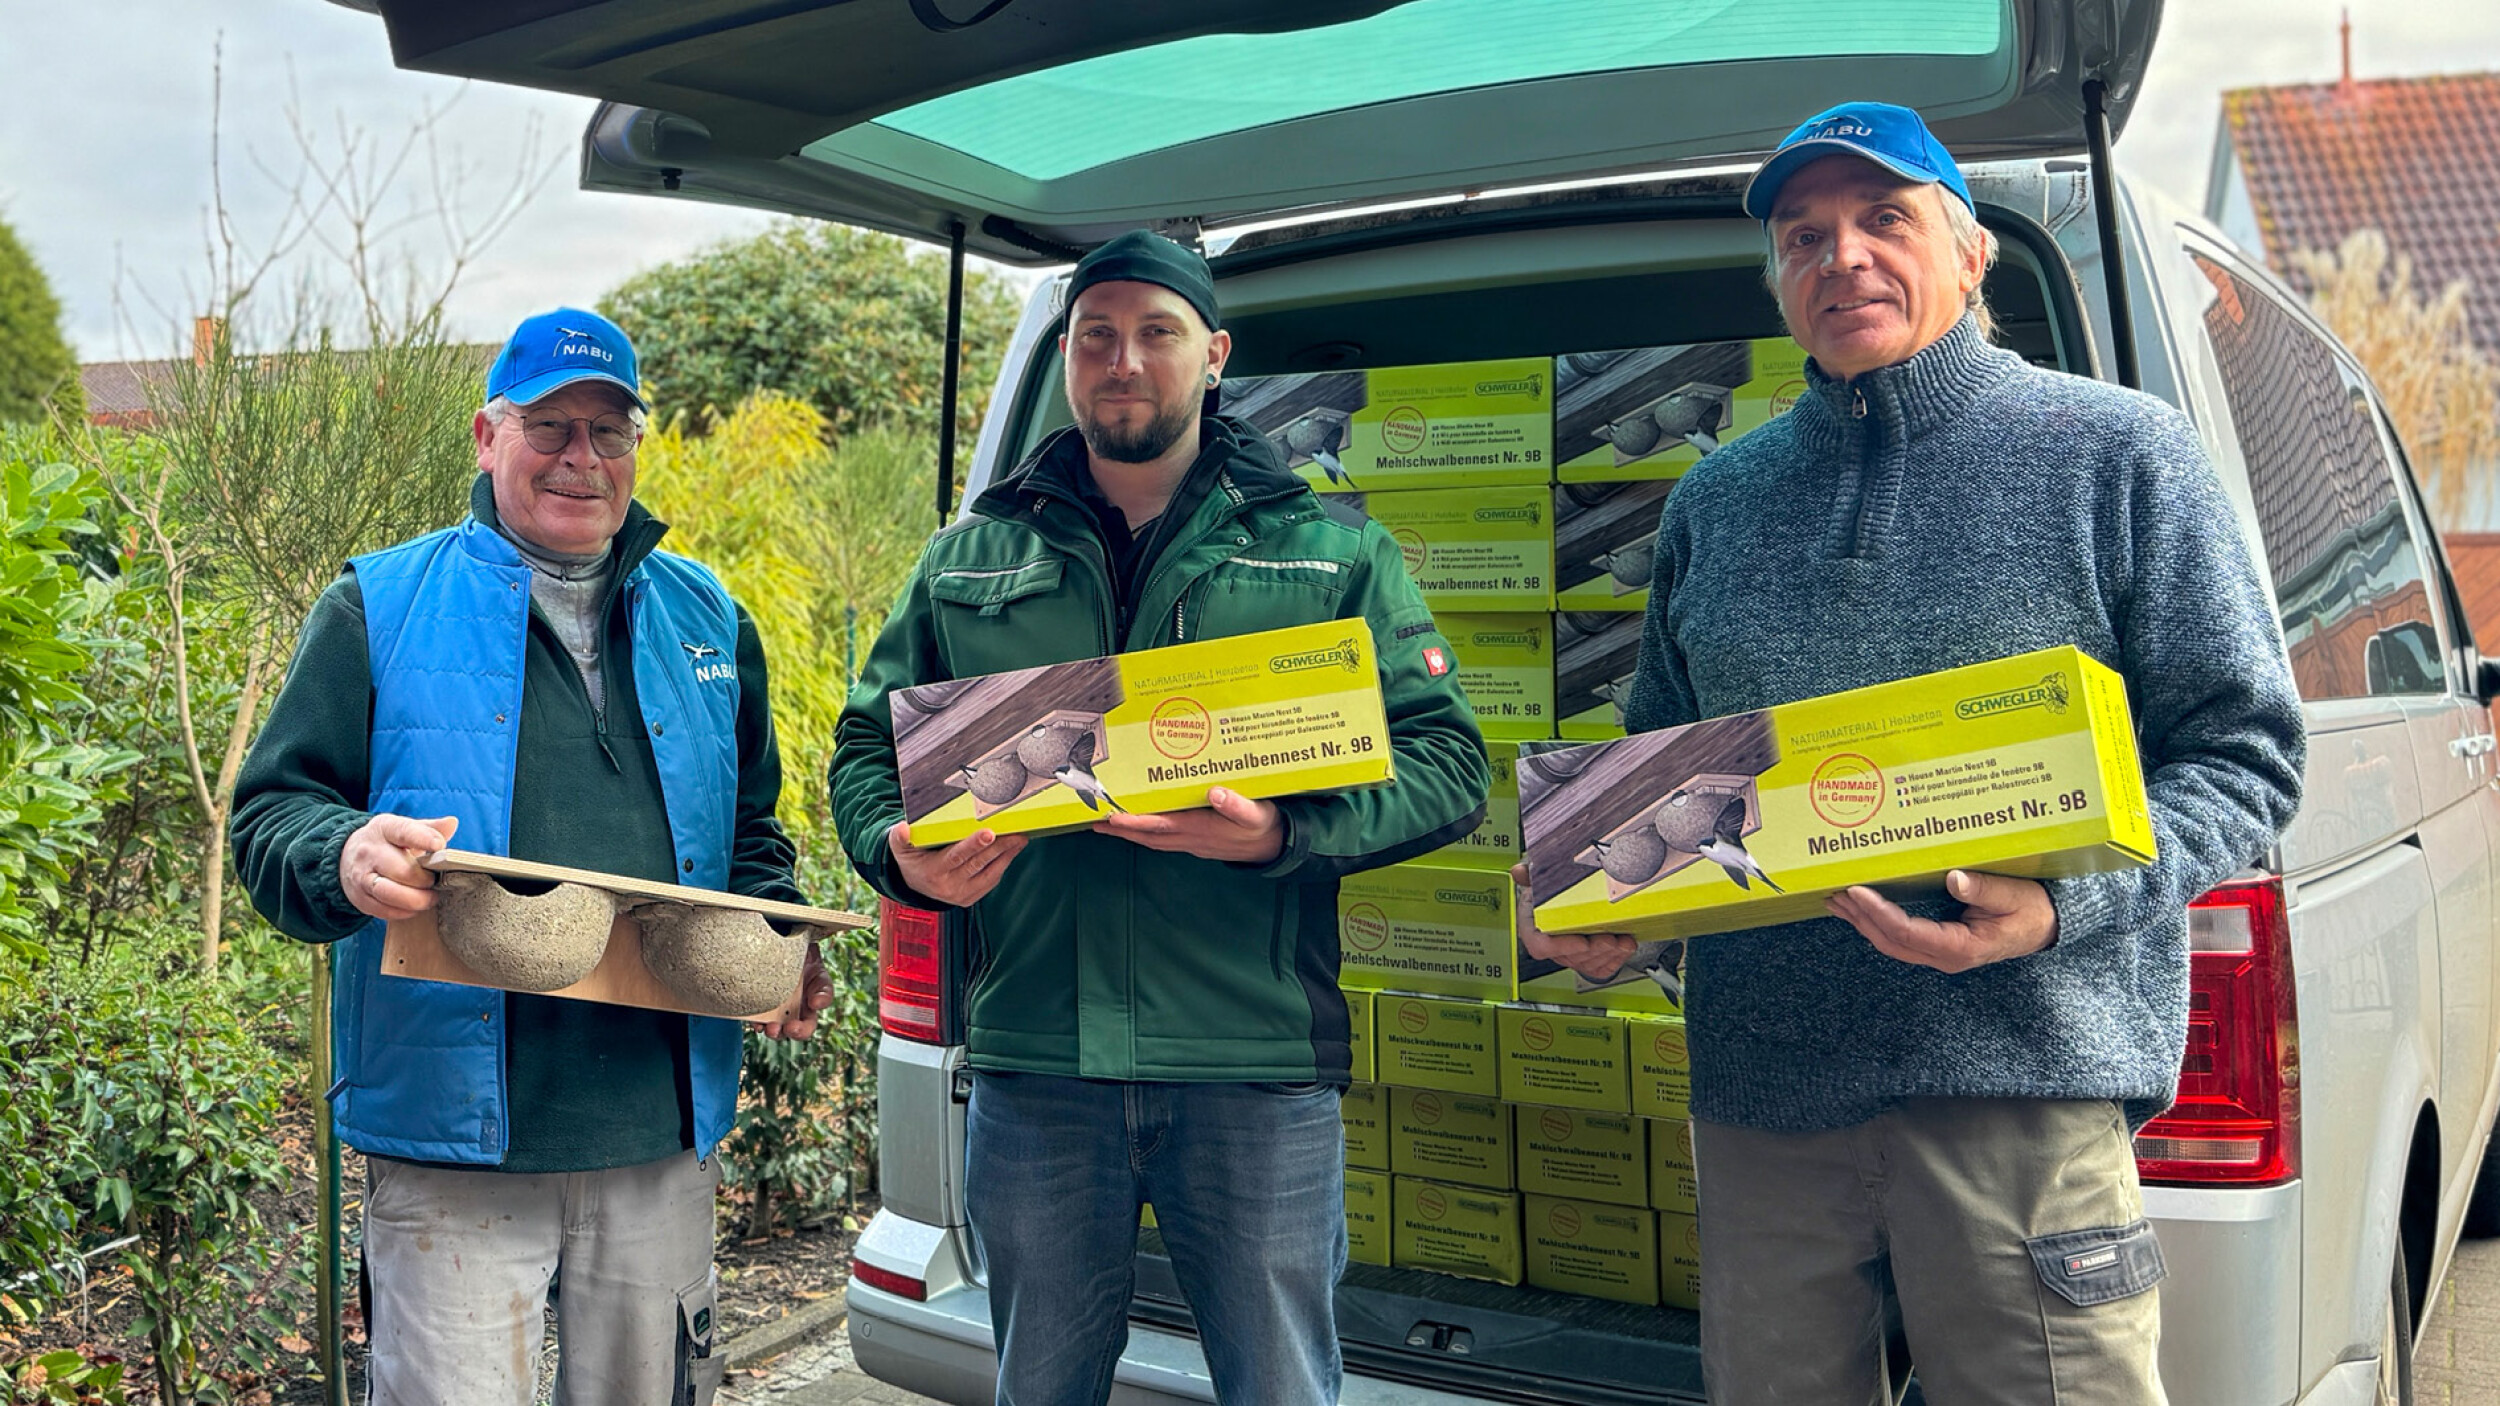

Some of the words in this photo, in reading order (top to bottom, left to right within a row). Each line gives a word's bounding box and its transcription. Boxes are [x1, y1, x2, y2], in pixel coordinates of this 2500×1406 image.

[562, 344, 613, 363] NABU
[1478, 382, 1529, 393] SCHWEGLER
[1376, 452, 1499, 469] Mehlschwalbennest
[1503, 450, 1521, 464] Nr.
[1525, 449, 1541, 463] 9B
[1476, 510, 1528, 520] SCHWEGLER
[1416, 578, 1499, 591] hwalbennest
[1502, 576, 1521, 590] Nr.
[1524, 576, 1541, 590] 9B
[1273, 650, 1342, 670] SCHWEGLER
[695, 663, 736, 683] NABU
[1134, 671, 1207, 690] NATURMATERIAL
[1502, 703, 1521, 716] Nr.
[1524, 703, 1542, 716] 9B
[1960, 689, 2048, 716] SCHWEGLER
[1154, 718, 1205, 730] HANDMADE
[1790, 720, 1878, 746] NATURMATERIAL
[1889, 709, 1943, 727] Holzbeton
[1156, 728, 1165, 737] in
[1166, 728, 1204, 741] Germany
[1147, 746, 1316, 783] Mehlschwalbennest
[1320, 741, 1347, 759] Nr.
[1351, 735, 1373, 754] 9B
[1908, 771, 1934, 782] House
[1935, 765, 1964, 777] Martin
[1964, 762, 1984, 772] Nest
[1985, 757, 1997, 768] 9B
[1926, 781, 1945, 792] pour
[1946, 773, 1988, 788] hirondelle
[1989, 769, 2001, 779] de
[2032, 761, 2045, 772] 9B
[1816, 779, 1878, 792] HANDMADE
[1912, 796, 1931, 806] Nidi
[1975, 786, 1990, 797] per
[2040, 772, 2053, 783] 9B
[1818, 792, 1828, 801] in
[1830, 792, 1876, 805] Germany
[1807, 805, 2016, 856] Mehlschwalbennest
[2022, 798, 2053, 820] Nr.
[2058, 789, 2088, 814] 9B
[1471, 833, 1490, 846] Nr.
[1493, 834, 1510, 847] 9B
[1438, 891, 1489, 903] SCHWEGLER
[1341, 951, 1460, 975] Mehlschwalbennest
[1464, 962, 1482, 977] Nr.
[1486, 964, 1502, 978] 9B
[1388, 1034, 1460, 1050] Mehlschwalbennest
